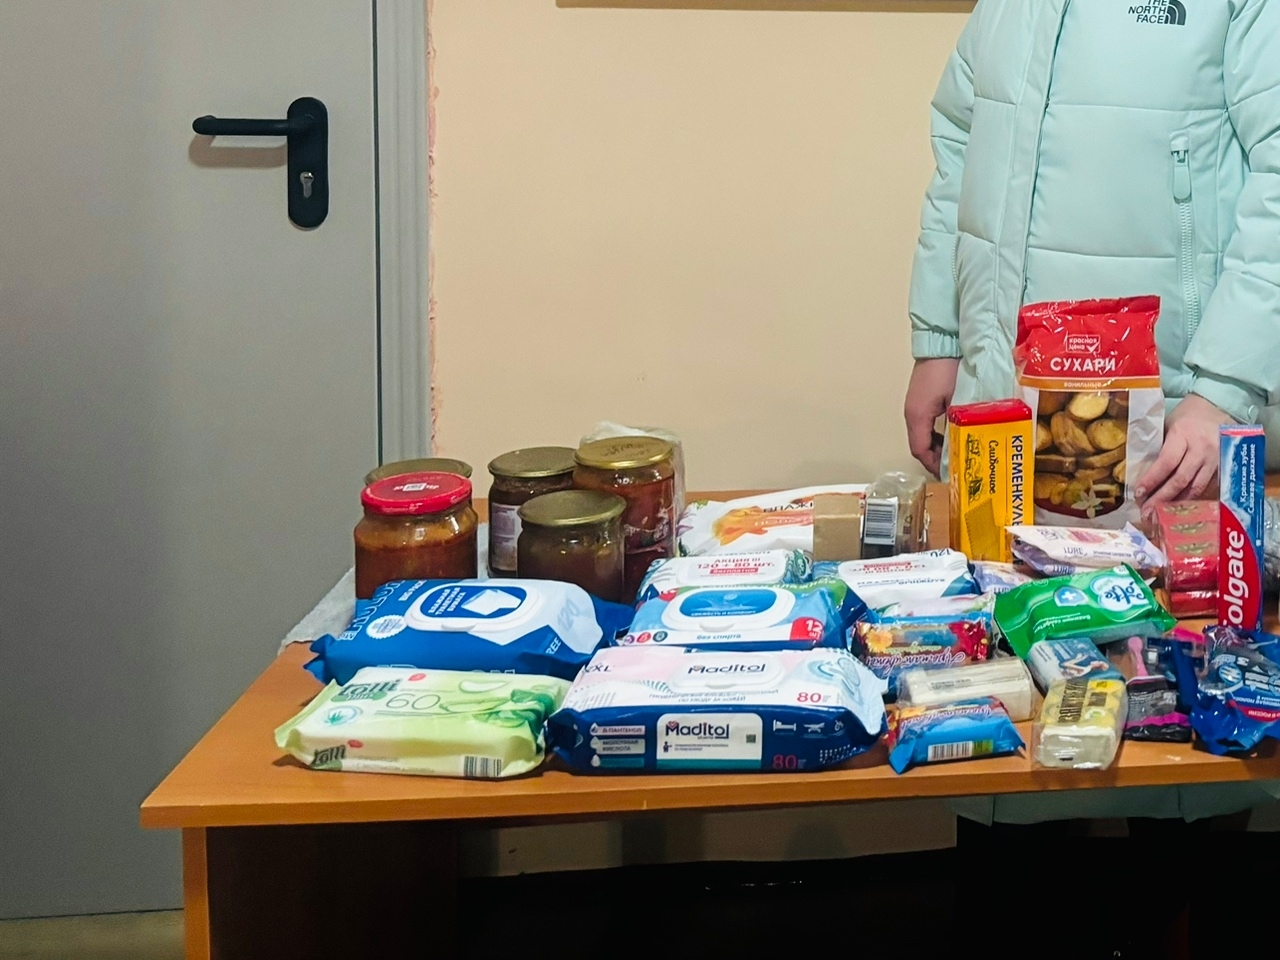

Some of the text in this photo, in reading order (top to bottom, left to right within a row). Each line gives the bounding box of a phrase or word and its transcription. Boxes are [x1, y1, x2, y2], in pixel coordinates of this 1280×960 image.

[1128, 6, 1167, 15] NORTH
[1136, 14, 1165, 25] FACE
[1050, 357, 1116, 372] СУХАРИ
[1239, 443, 1249, 502] Крепкие зубы
[1247, 443, 1257, 514] Свежее дыхание
[1222, 530, 1250, 628] olgate
[557, 600, 581, 628] 120
[713, 633, 742, 641] спирта
[688, 664, 766, 675] Maditol
[386, 693, 441, 711] 60
[796, 692, 822, 702] 80
[665, 721, 730, 739] Maditol
[772, 755, 797, 769] 80
